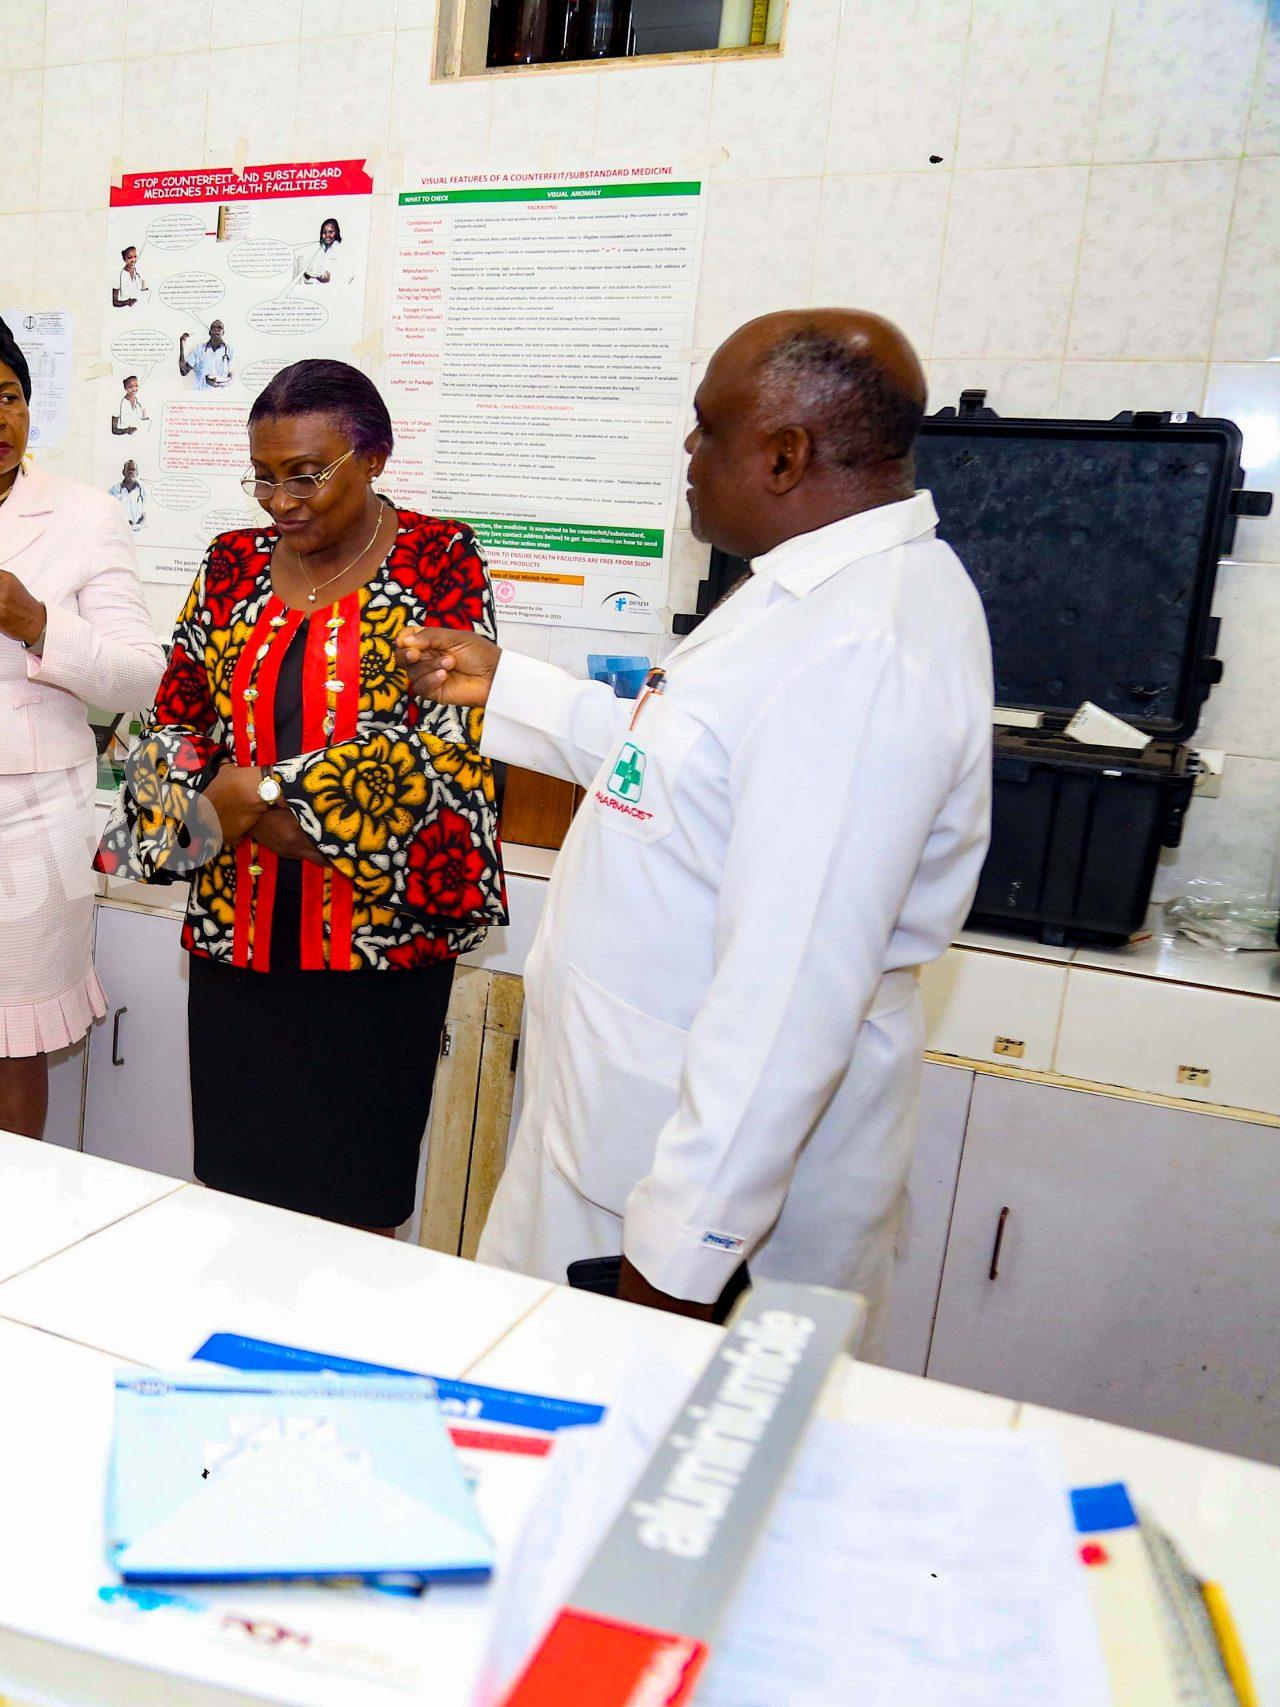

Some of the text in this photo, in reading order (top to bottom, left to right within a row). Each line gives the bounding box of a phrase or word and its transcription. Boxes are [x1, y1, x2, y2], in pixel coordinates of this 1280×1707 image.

[133, 167, 341, 188] STOP COUNTERFEIT AND SUBSTANDARD
[449, 174, 488, 183] FEATURES
[510, 169, 629, 181] COUNTERFEIT/SUBSTANDARD
[631, 166, 672, 175] MEDICINE
[143, 180, 328, 198] MEDICINES IN HEALTH FACILITIES
[577, 528, 645, 538] counterfeit/substandard,
[508, 573, 520, 581] local
[595, 791, 654, 820] PHARMACIST
